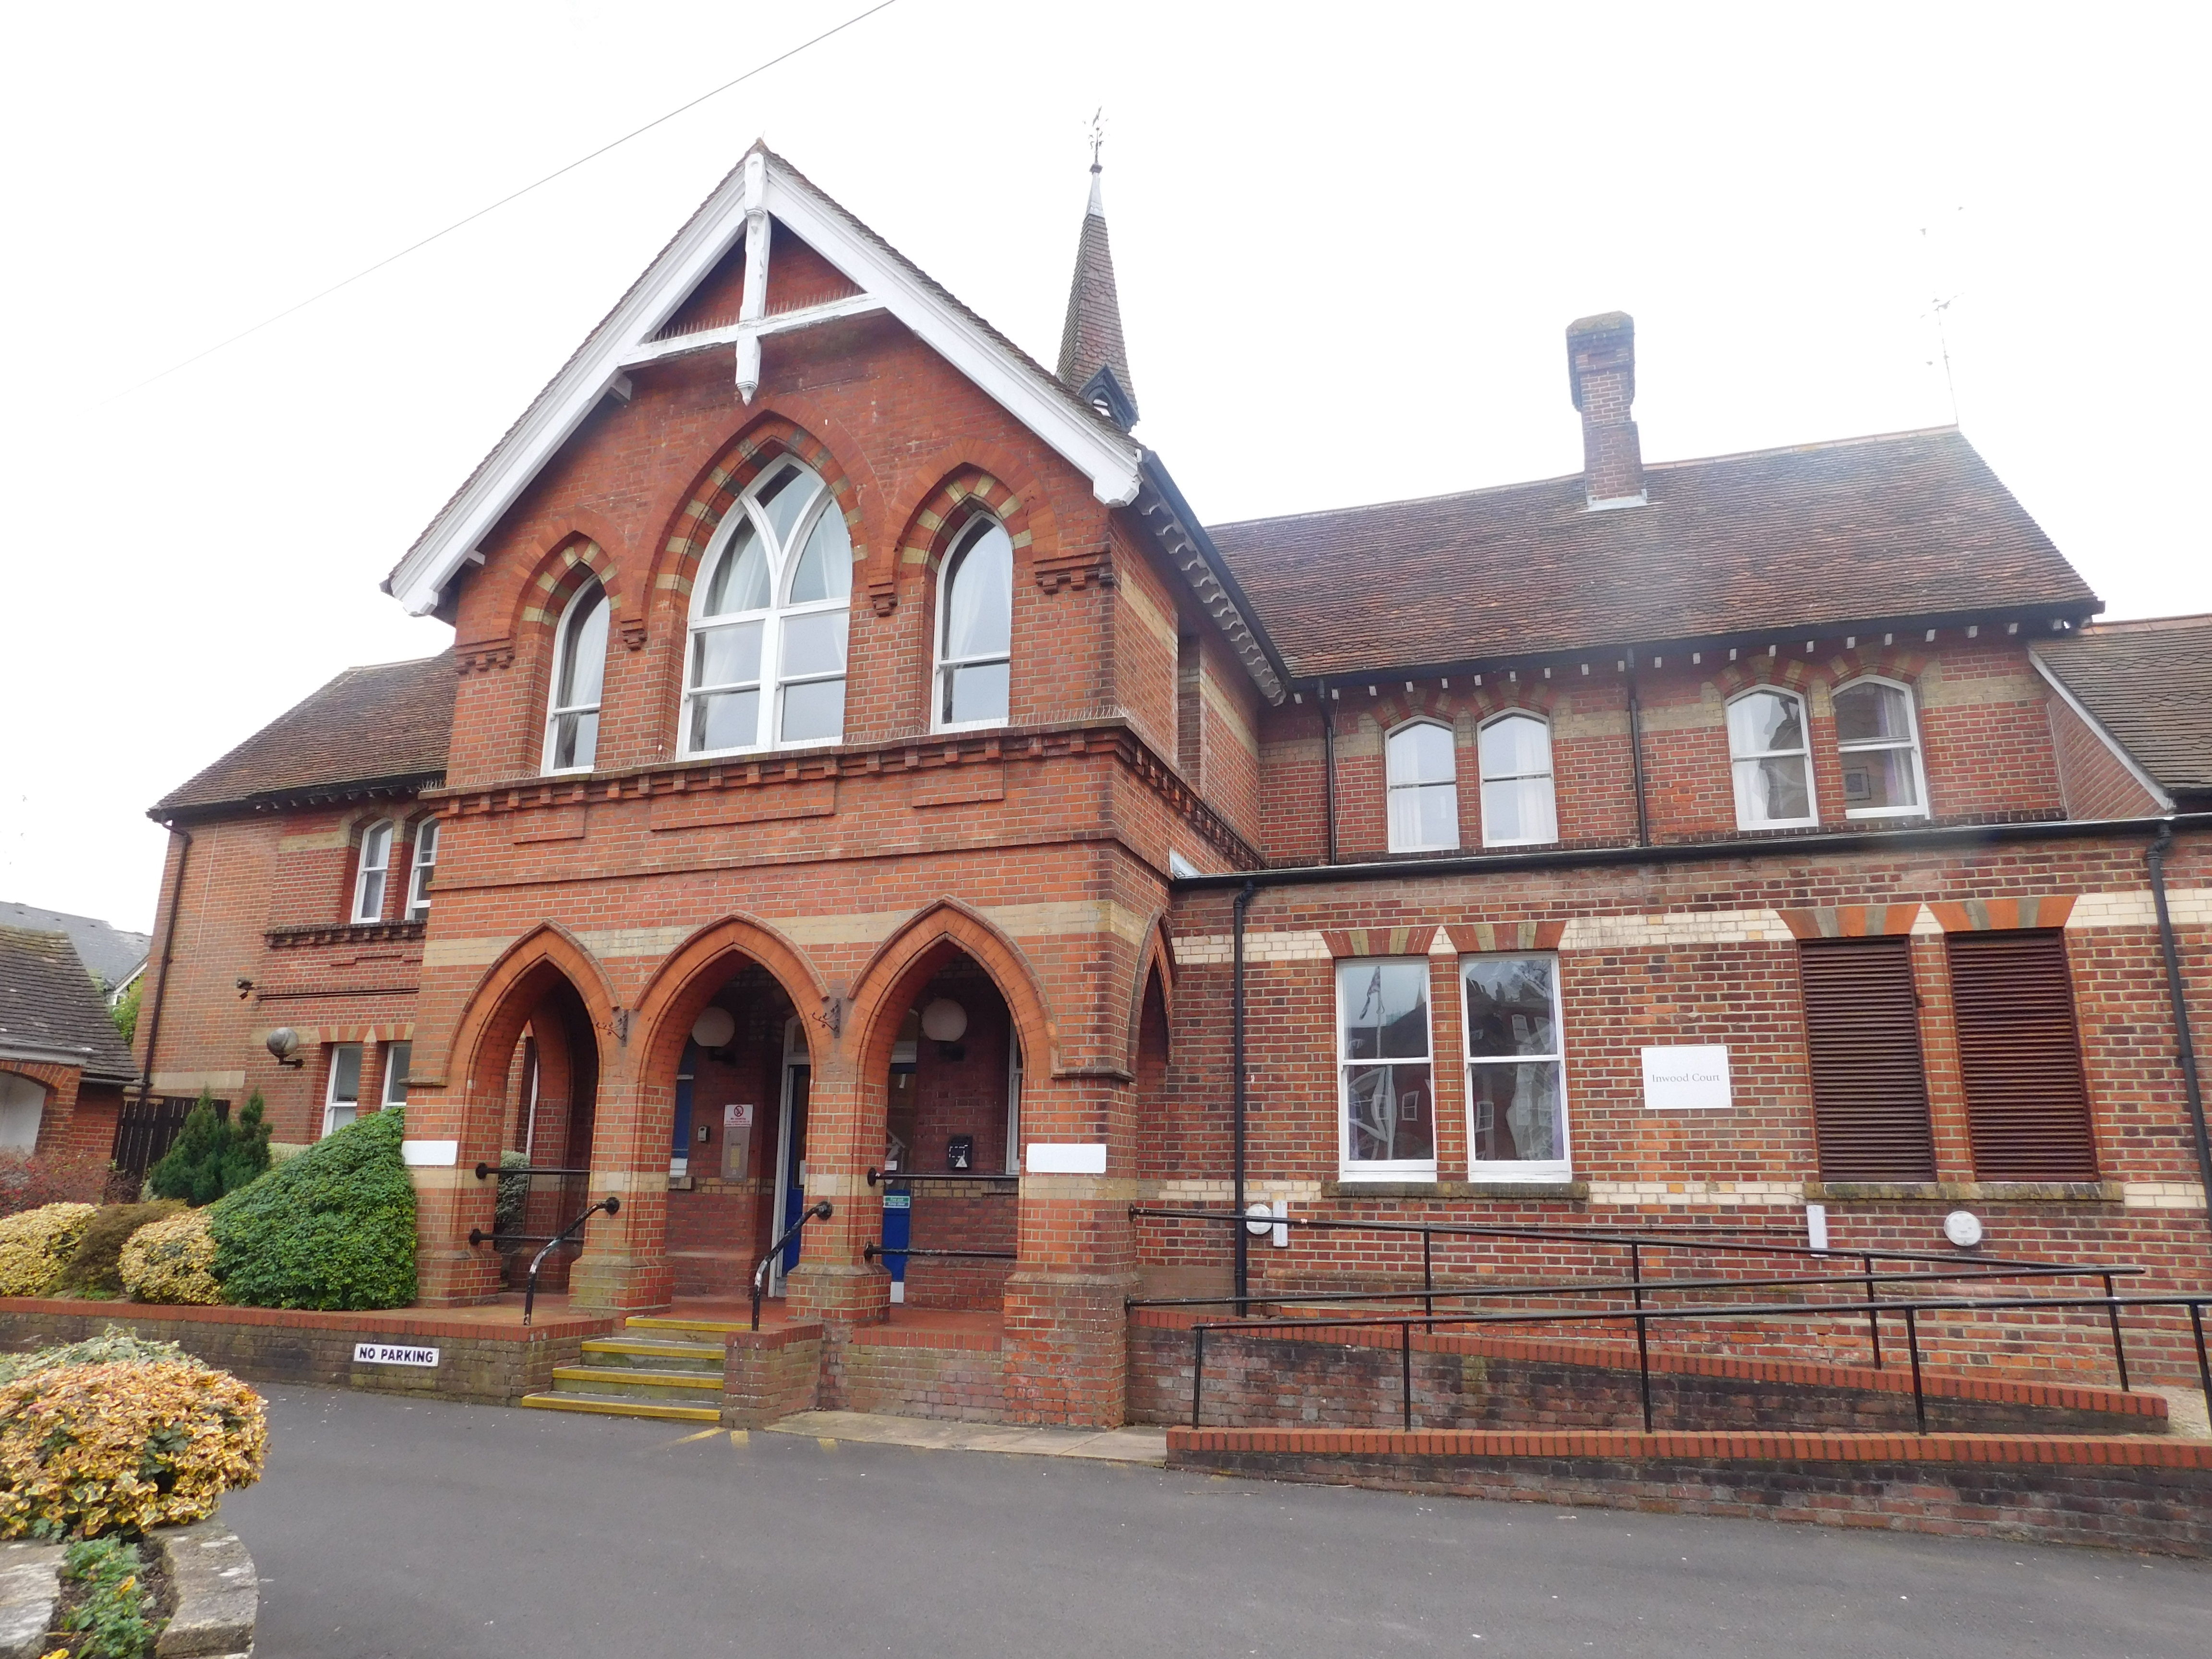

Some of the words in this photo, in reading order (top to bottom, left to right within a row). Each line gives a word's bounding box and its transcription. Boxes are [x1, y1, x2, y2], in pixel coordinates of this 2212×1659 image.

[1652, 1073, 1689, 1082] Inwood
[1692, 1073, 1720, 1082] Court
[360, 1347, 375, 1359] NO
[381, 1348, 433, 1363] PARKING
